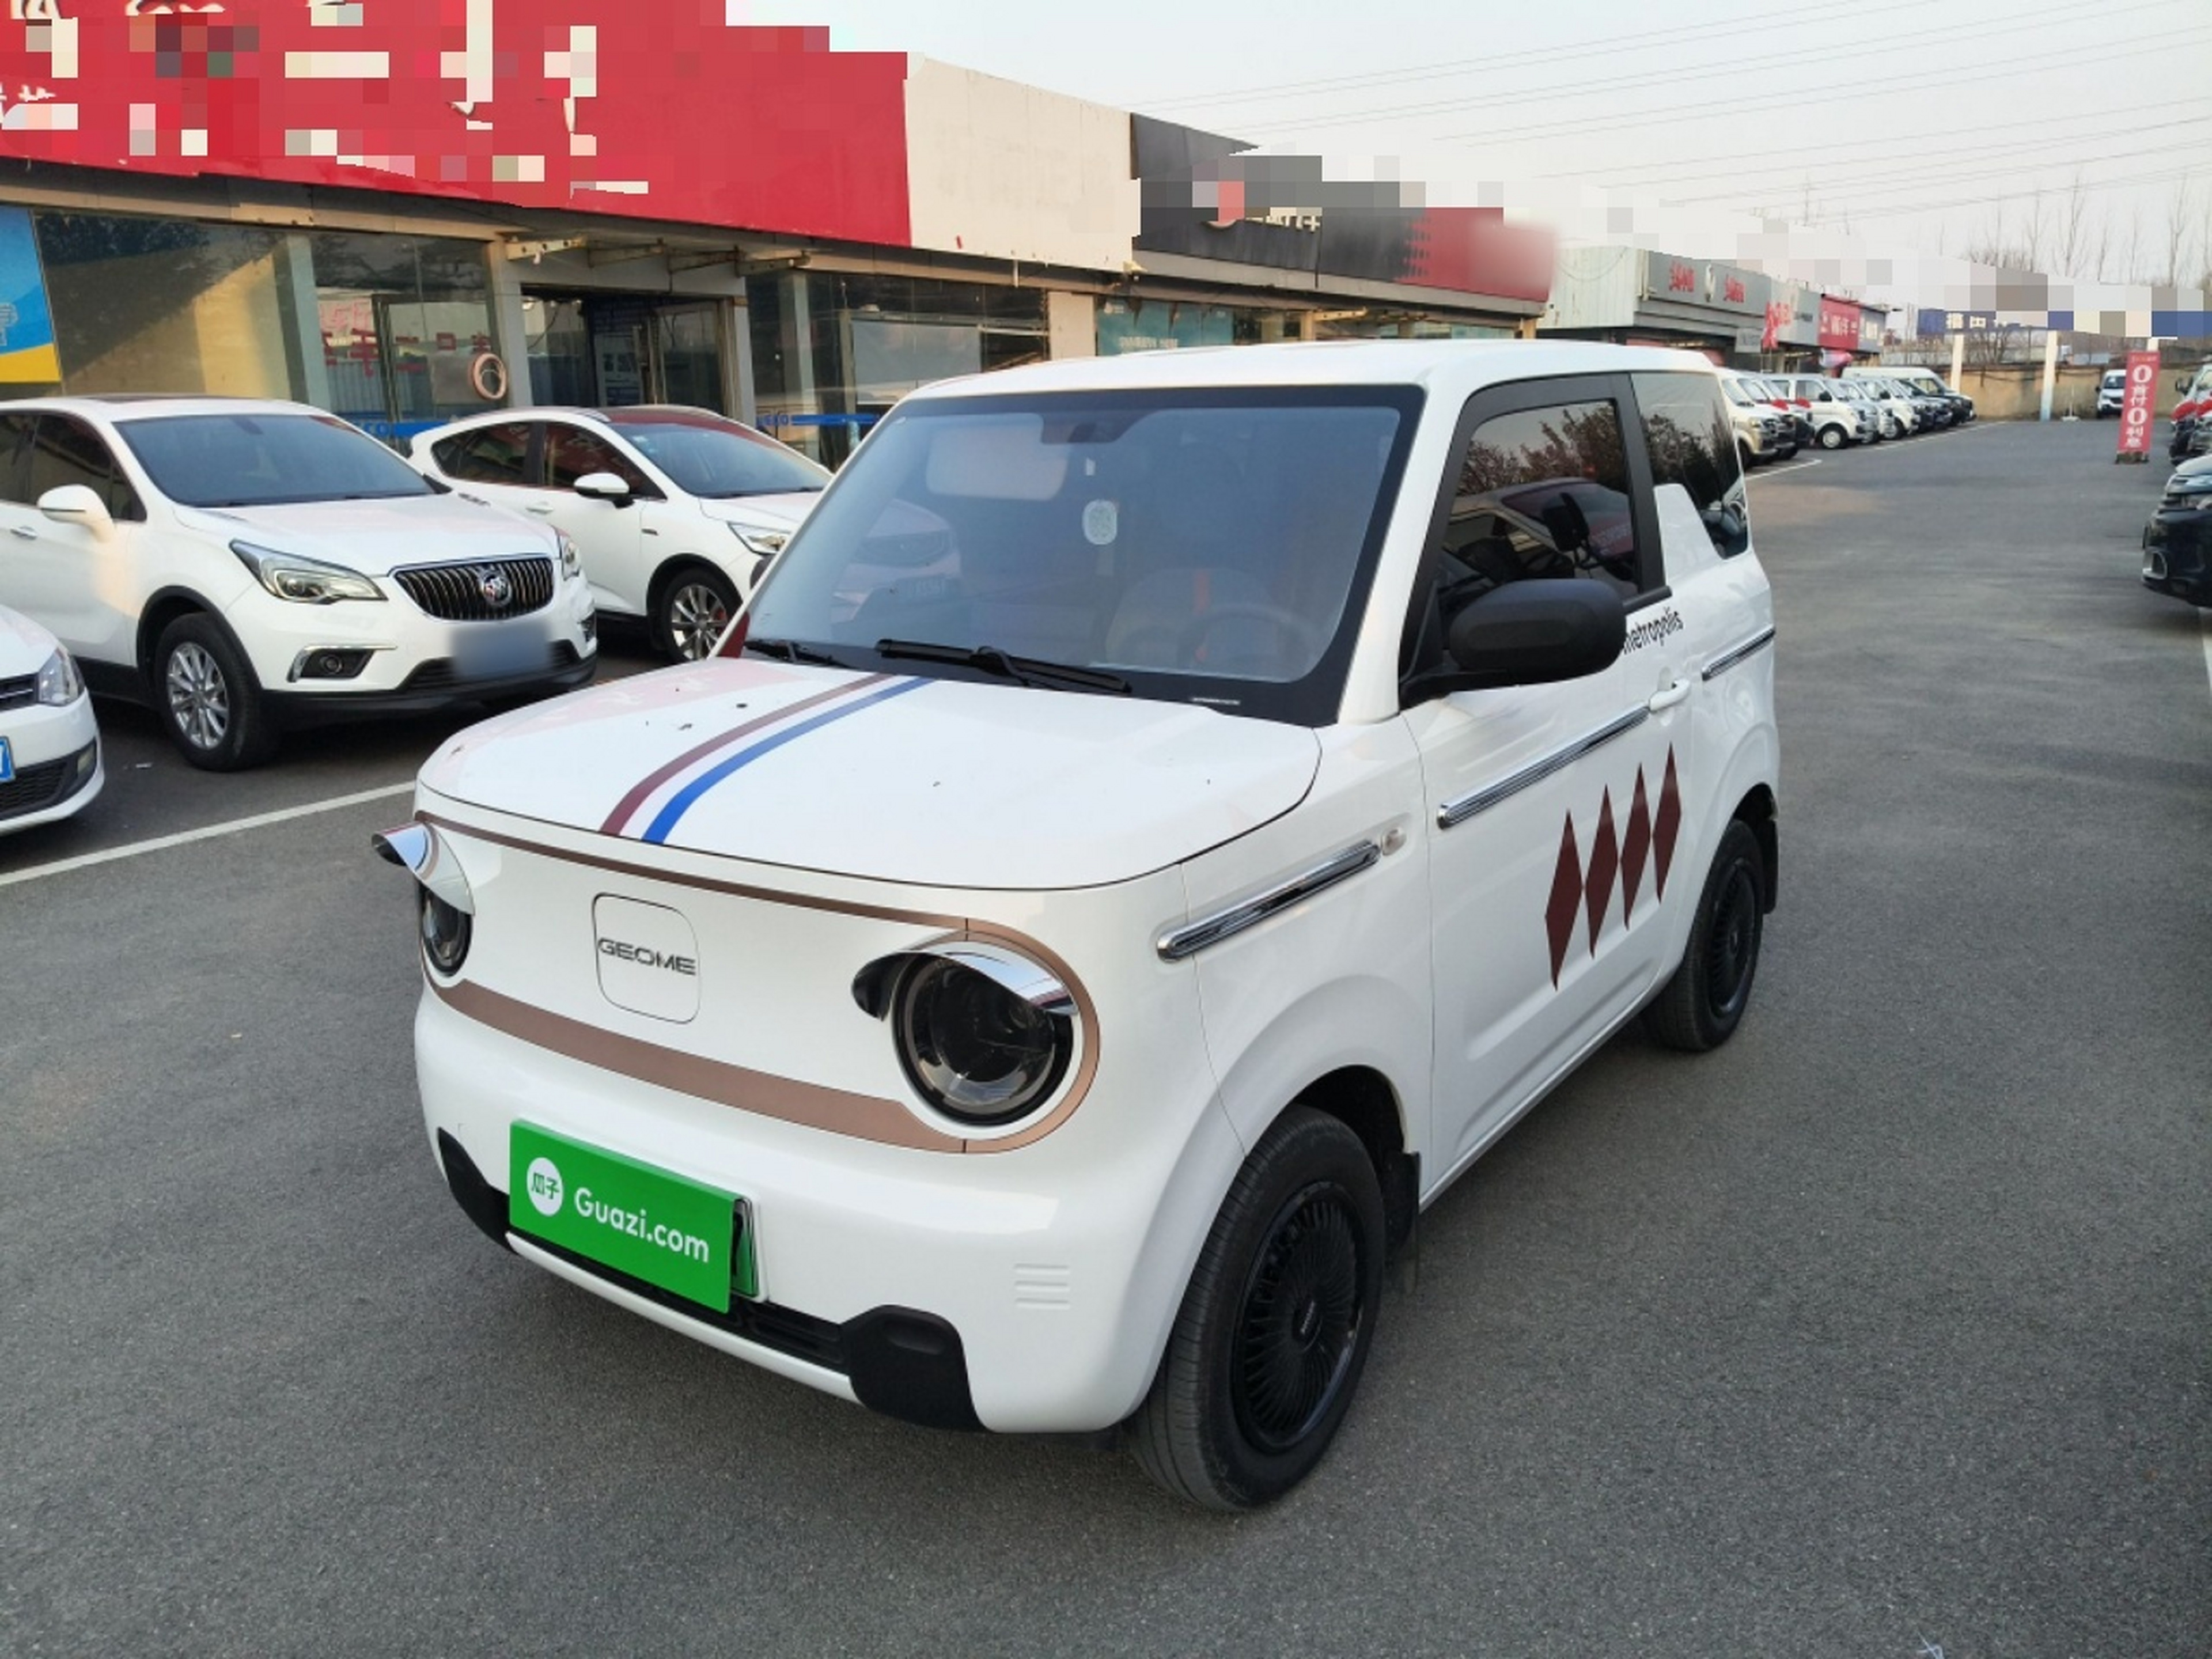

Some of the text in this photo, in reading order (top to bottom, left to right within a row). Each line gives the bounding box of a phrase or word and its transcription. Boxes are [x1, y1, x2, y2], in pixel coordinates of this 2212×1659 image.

[597, 937, 696, 975] GEOME
[531, 1172, 560, 1200] 瓜子
[574, 1187, 709, 1263] Guazi.com
